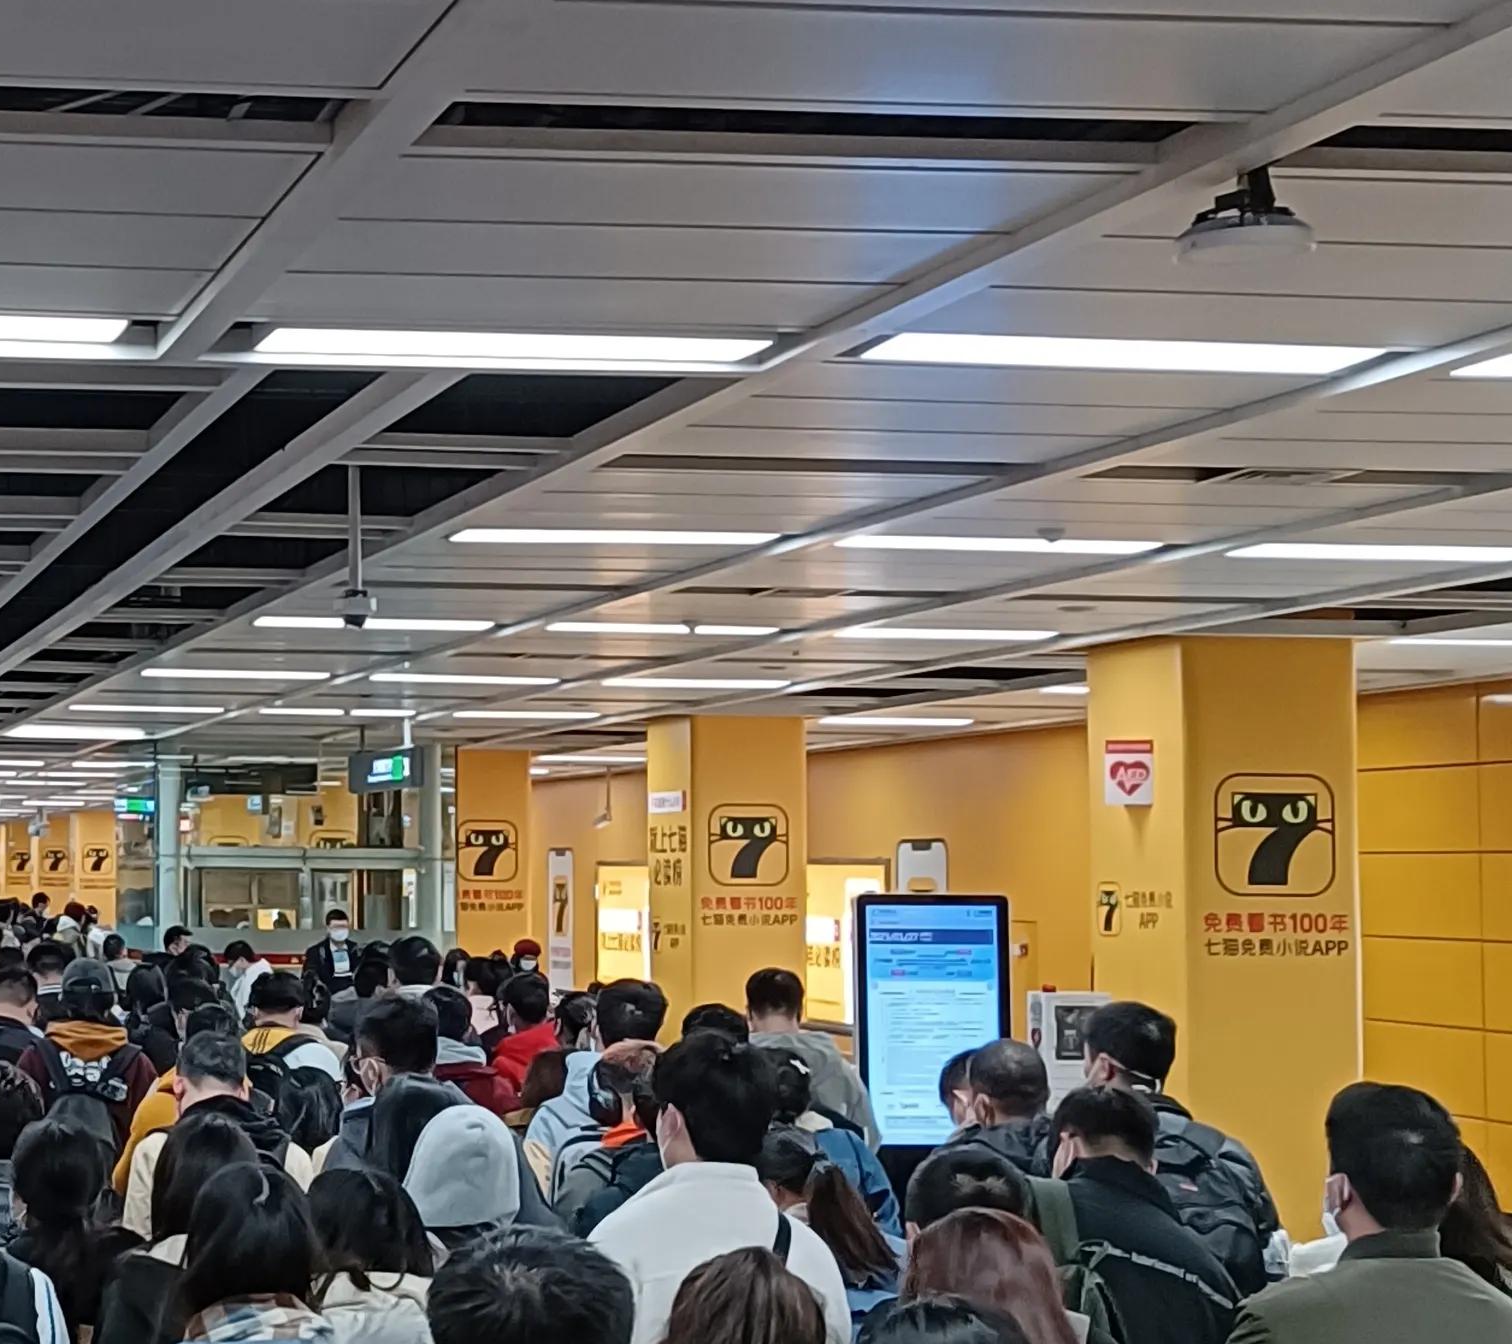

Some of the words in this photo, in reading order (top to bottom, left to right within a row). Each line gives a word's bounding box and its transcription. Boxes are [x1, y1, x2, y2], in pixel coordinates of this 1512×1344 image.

[1203, 912, 1349, 934] 免费看书100年
[1205, 937, 1349, 957] 七猫免费小说APP
